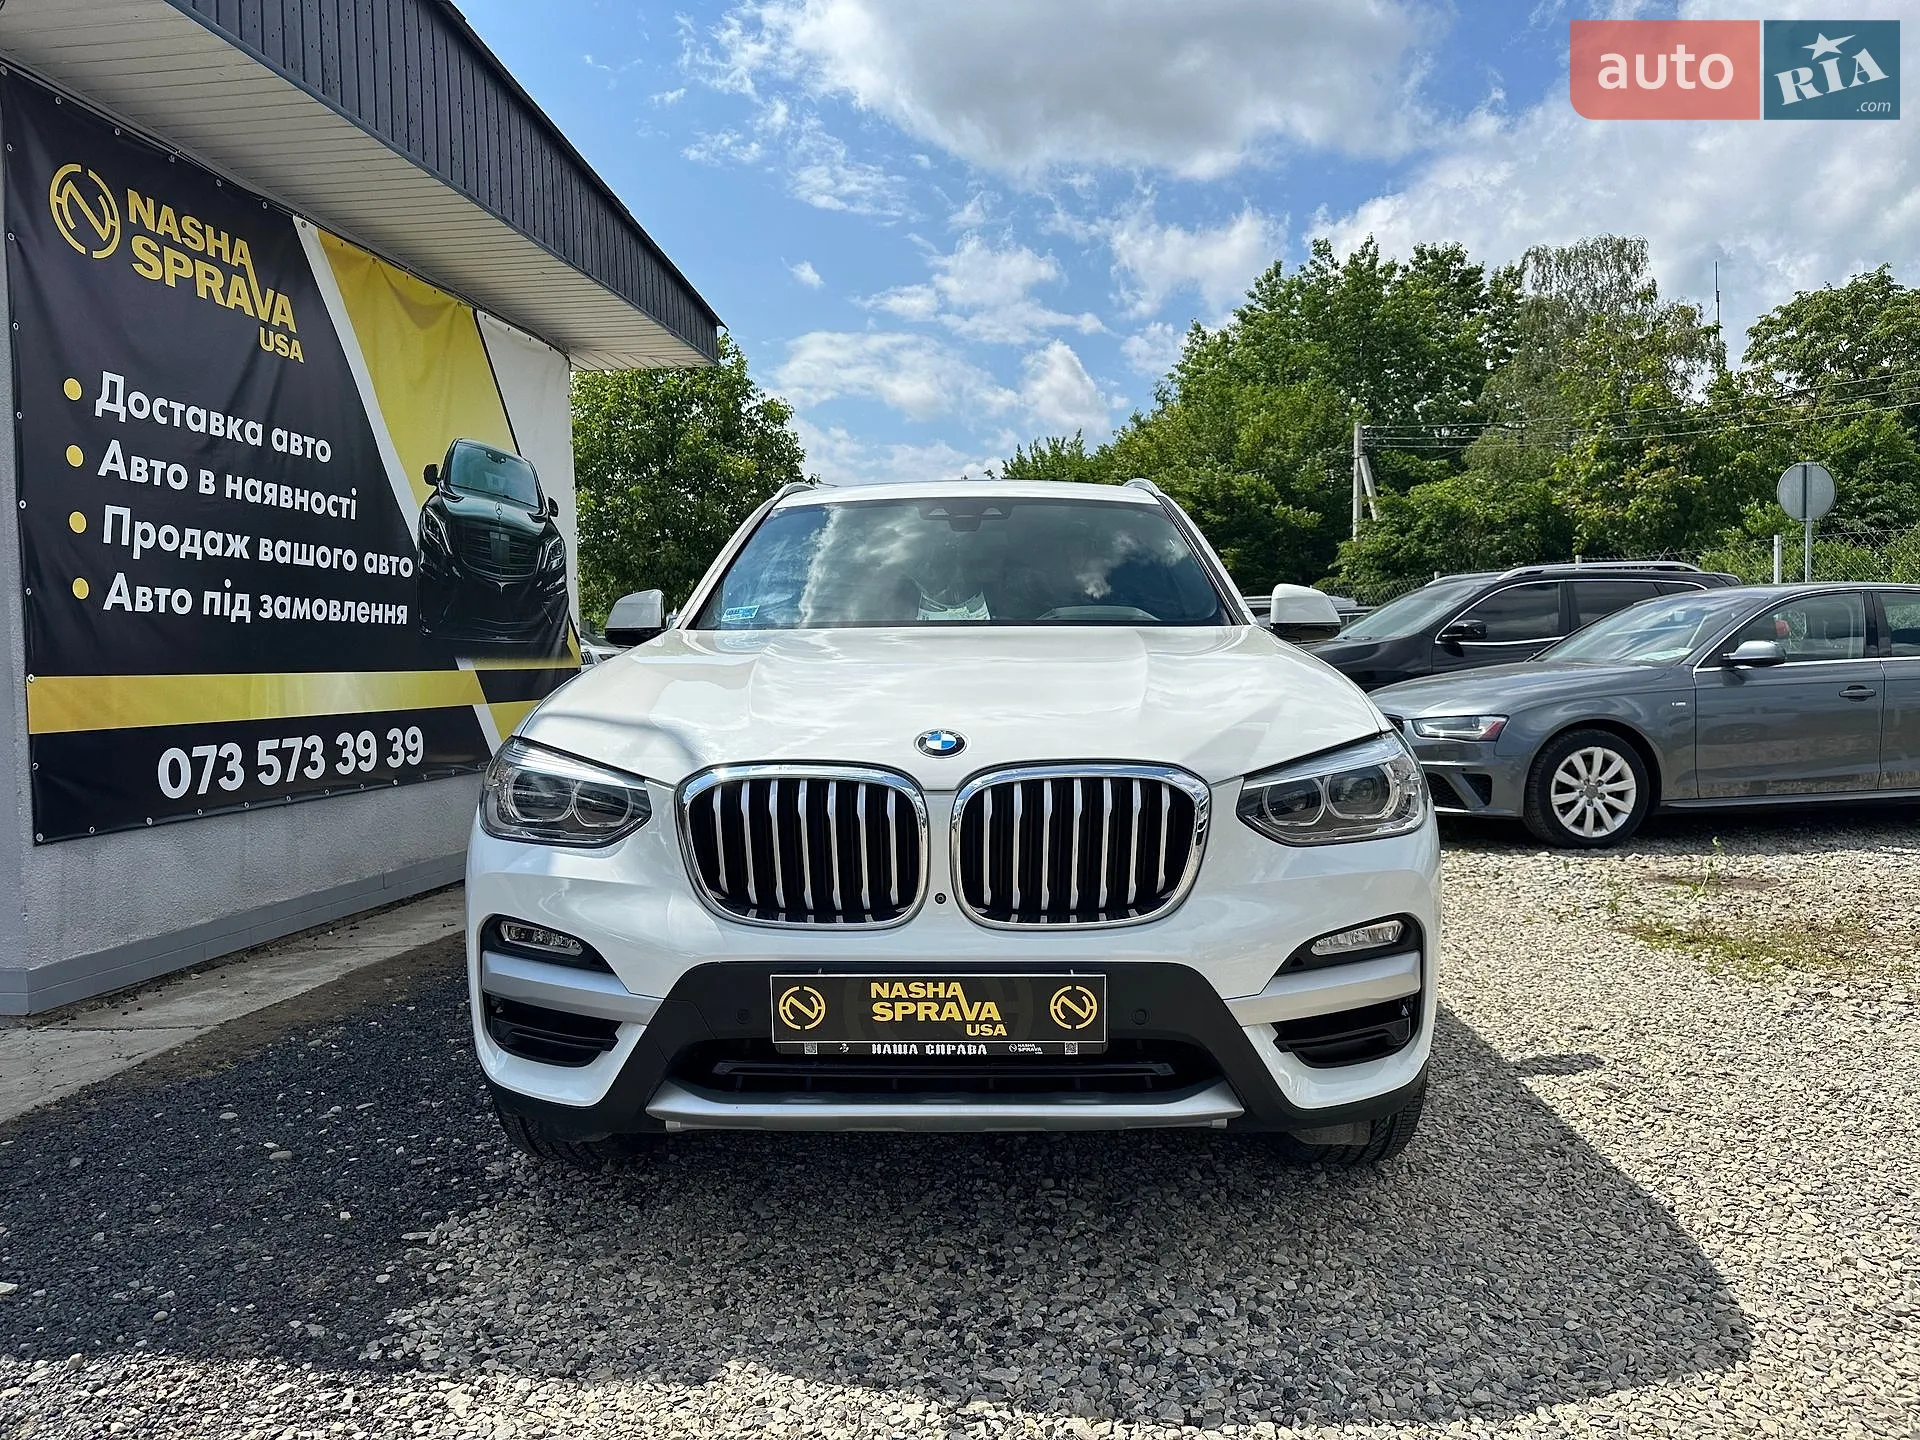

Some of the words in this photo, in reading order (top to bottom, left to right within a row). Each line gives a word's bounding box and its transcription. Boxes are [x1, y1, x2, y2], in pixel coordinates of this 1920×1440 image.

[127, 188, 251, 268] NASHA
[131, 235, 297, 333] SPRAVA
[259, 326, 304, 363] USA
[94, 370, 263, 447] Доставка
[271, 426, 331, 463] авто
[97, 438, 189, 491] Авто
[198, 468, 217, 495] в
[225, 474, 357, 520] наявності
[102, 504, 250, 560] Продаж
[258, 537, 357, 573] вашого
[363, 551, 414, 578] авто
[102, 572, 193, 615] Авто
[202, 578, 251, 623] під
[259, 594, 408, 625] замовлення
[158, 742, 245, 799] 073
[257, 735, 326, 784] 573
[336, 730, 377, 775] 39
[387, 725, 424, 768] 39
[870, 981, 961, 999] NASHA
[871, 1001, 1002, 1021] SPRAVA
[966, 1023, 1008, 1036] USA
